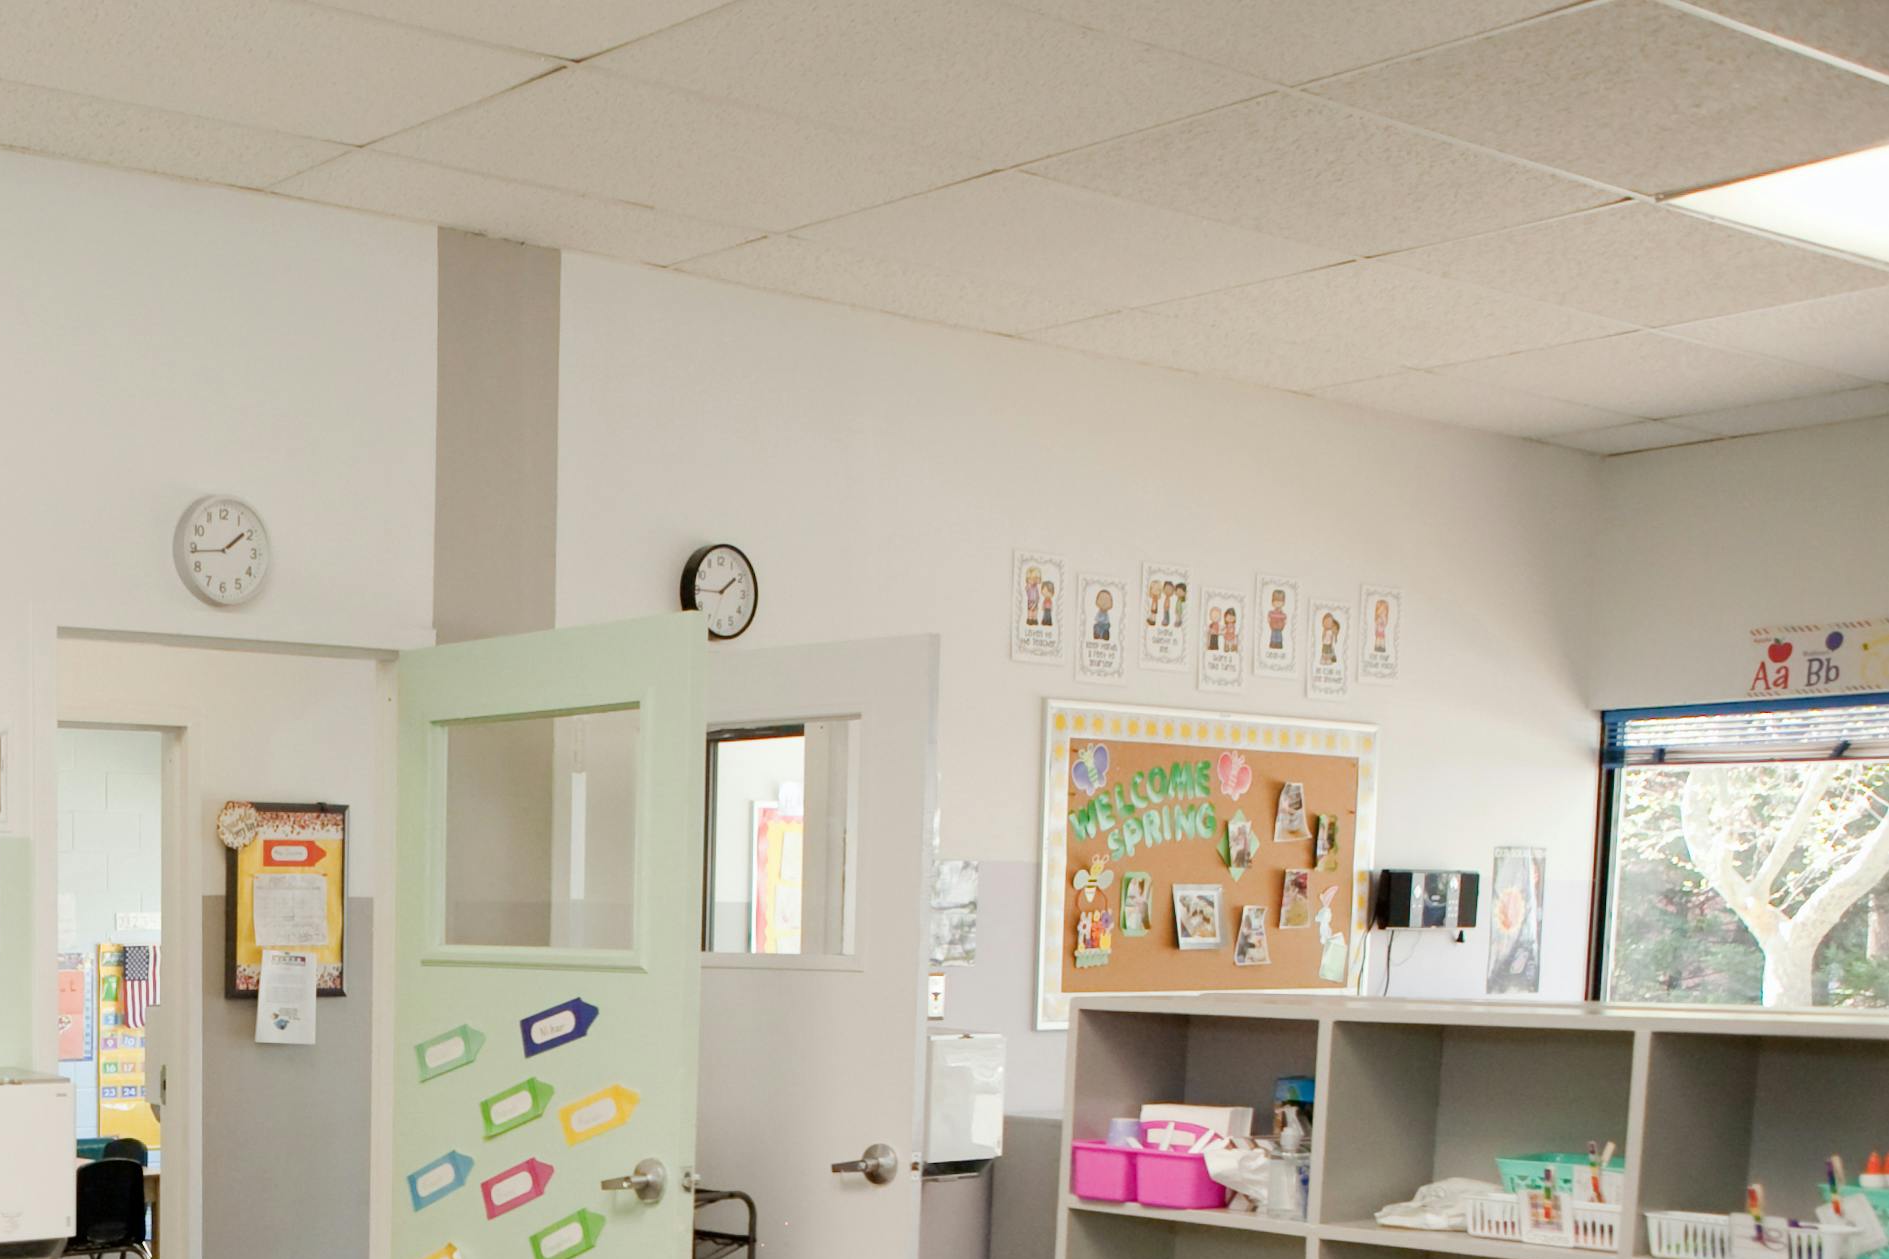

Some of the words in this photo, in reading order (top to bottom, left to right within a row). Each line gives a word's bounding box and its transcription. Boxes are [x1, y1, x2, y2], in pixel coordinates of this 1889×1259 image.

[206, 512, 212, 523] 11
[219, 509, 229, 520] 12
[238, 515, 240, 527] 1
[194, 524, 204, 536] 10
[246, 529, 253, 541] 2
[250, 548, 257, 560] 3
[194, 561, 201, 572] 8
[717, 556, 725, 566] 12
[245, 566, 252, 577] 4
[206, 575, 212, 586] 7
[737, 573, 743, 583] 2
[219, 582, 226, 593] 6
[235, 578, 242, 590] 5
[741, 590, 745, 600] 3
[717, 619, 722, 629] 6
[728, 616, 734, 626] 5
[1750, 661, 1789, 691] Aa
[1805, 657, 1839, 687] Bb
[1069, 760, 1211, 841] WELCOME
[1108, 803, 1216, 861] SPRING
[106, 1039, 114, 1047] 9
[123, 1036, 135, 1047] 10
[105, 1064, 116, 1072] 16
[123, 1063, 133, 1072] 17
[103, 1087, 116, 1096] 23
[123, 1087, 136, 1096] 24
